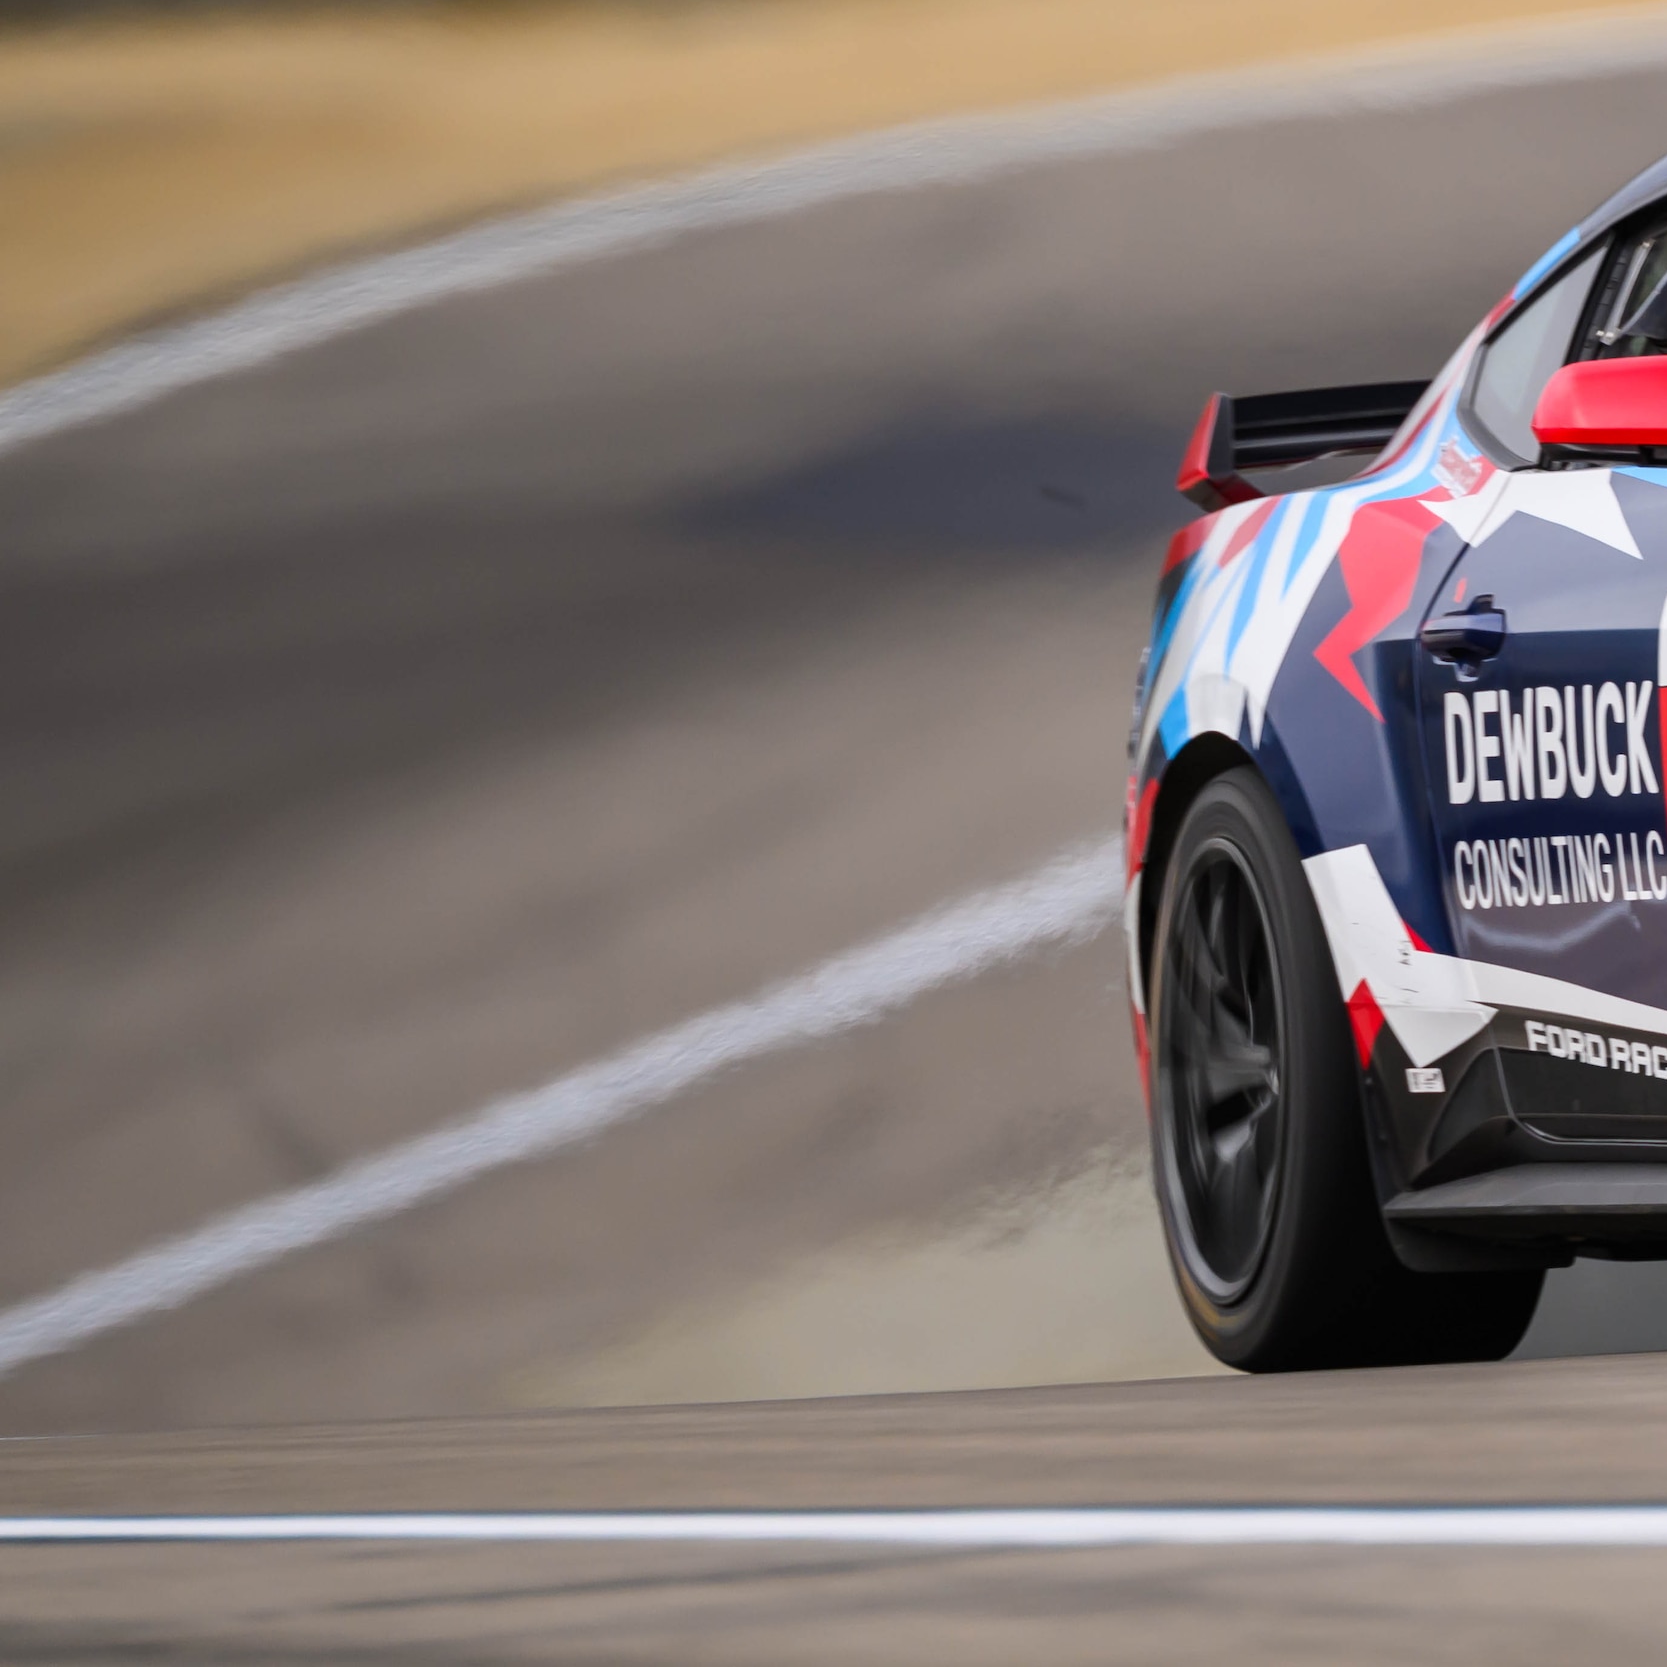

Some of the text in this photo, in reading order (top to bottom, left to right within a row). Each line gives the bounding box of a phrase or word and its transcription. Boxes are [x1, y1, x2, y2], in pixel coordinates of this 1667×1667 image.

[1444, 680, 1660, 804] DEWBUCK
[1453, 830, 1667, 910] CONSULTING LLC
[1524, 1020, 1608, 1068] FORD
